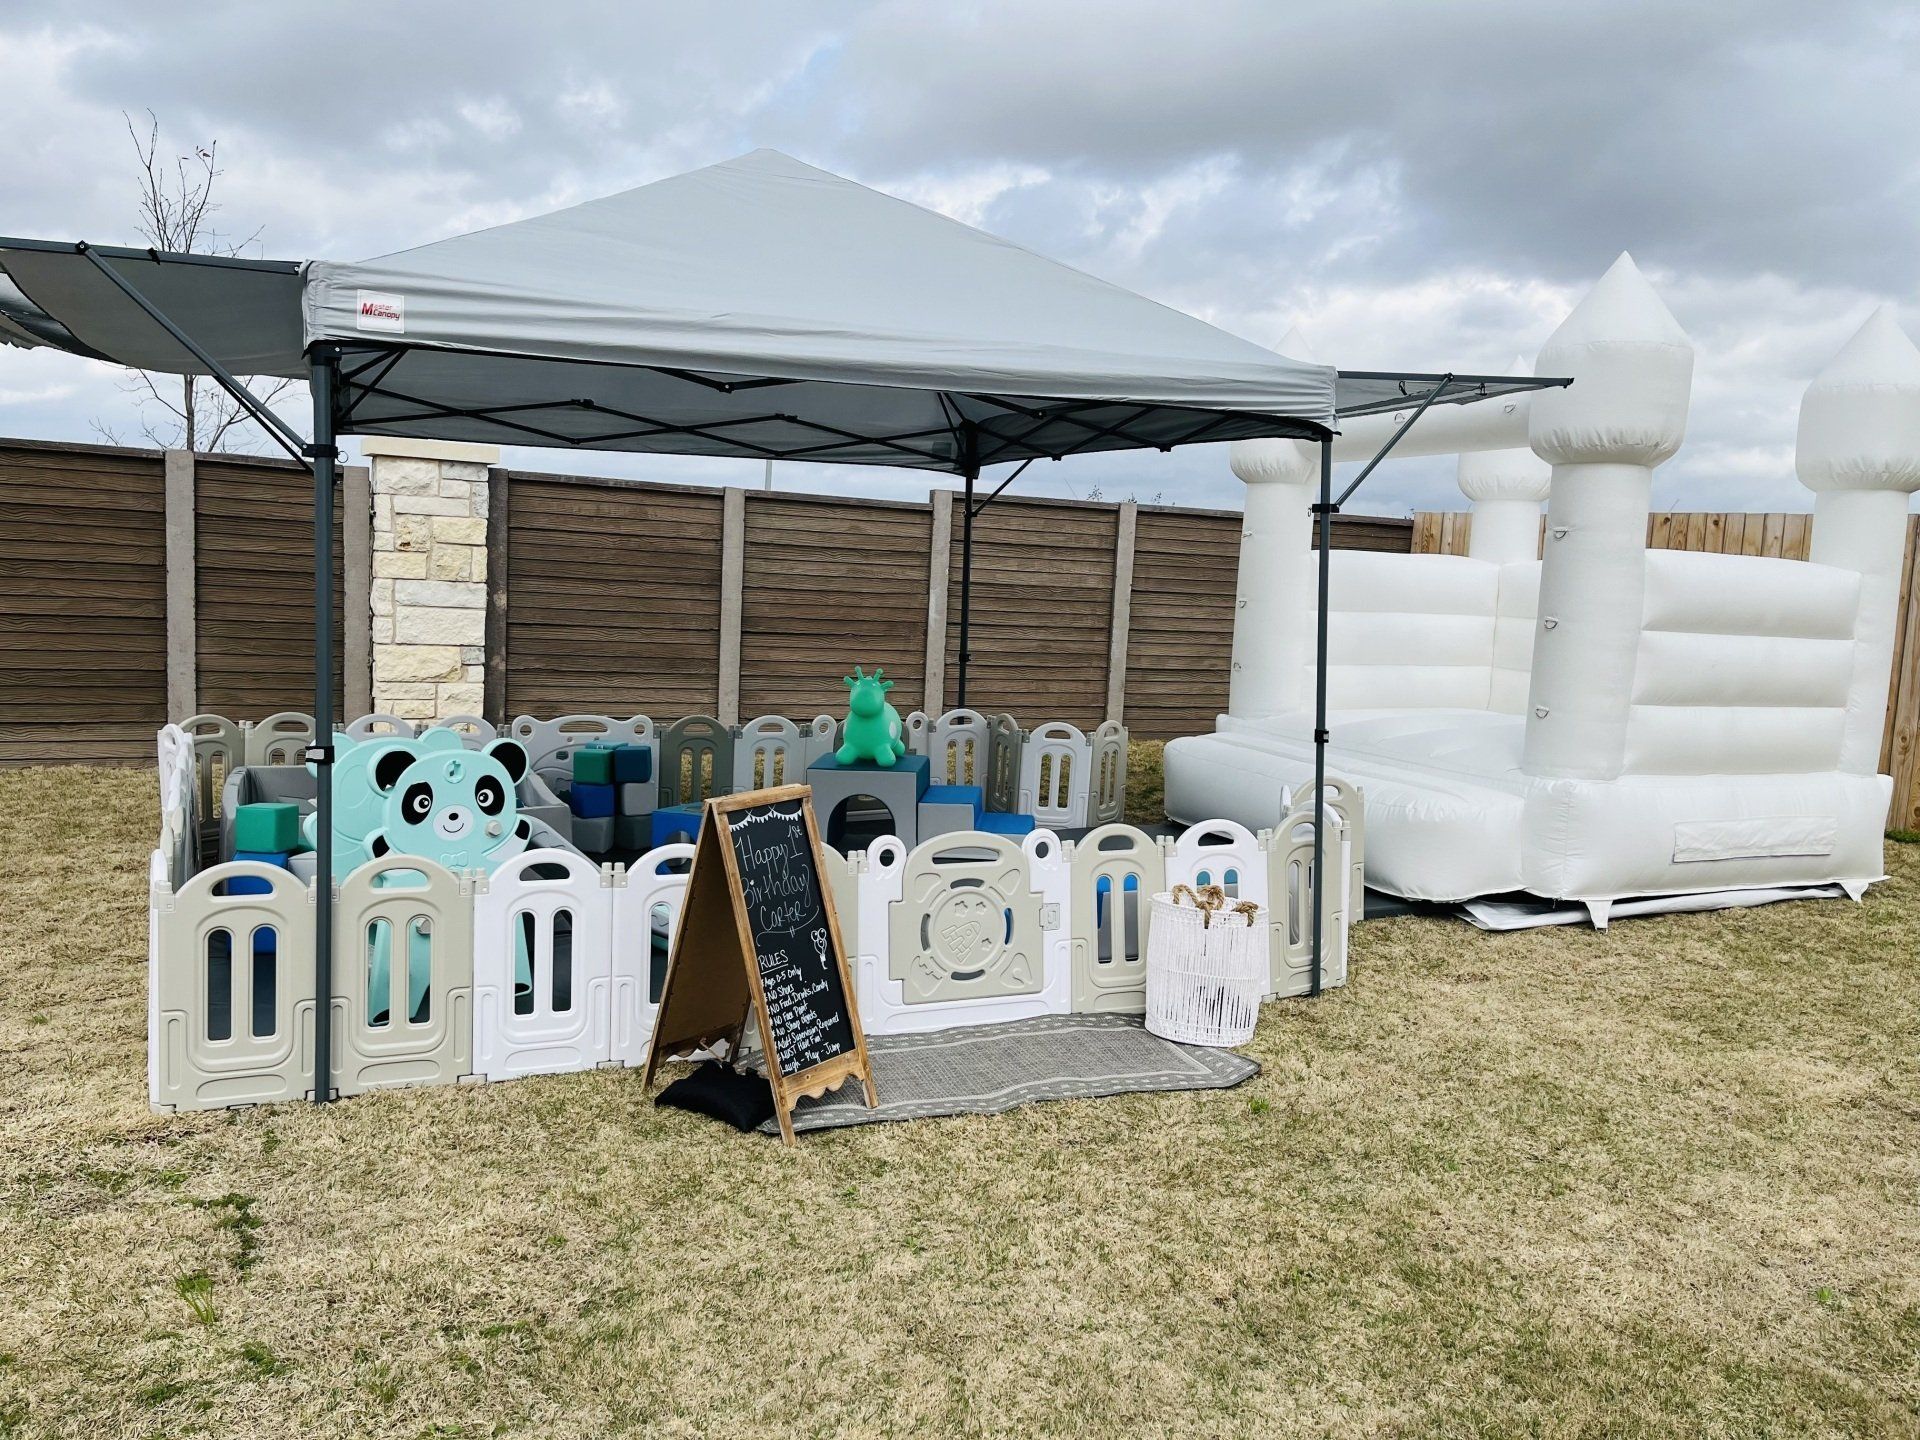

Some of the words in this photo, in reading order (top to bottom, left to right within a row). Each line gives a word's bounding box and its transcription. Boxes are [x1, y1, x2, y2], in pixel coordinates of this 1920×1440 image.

[373, 310, 400, 320] Canopy
[735, 834, 789, 877] Happy
[787, 825, 803, 858] 1st
[740, 864, 811, 909] Birthday
[758, 949, 789, 971] RULES
